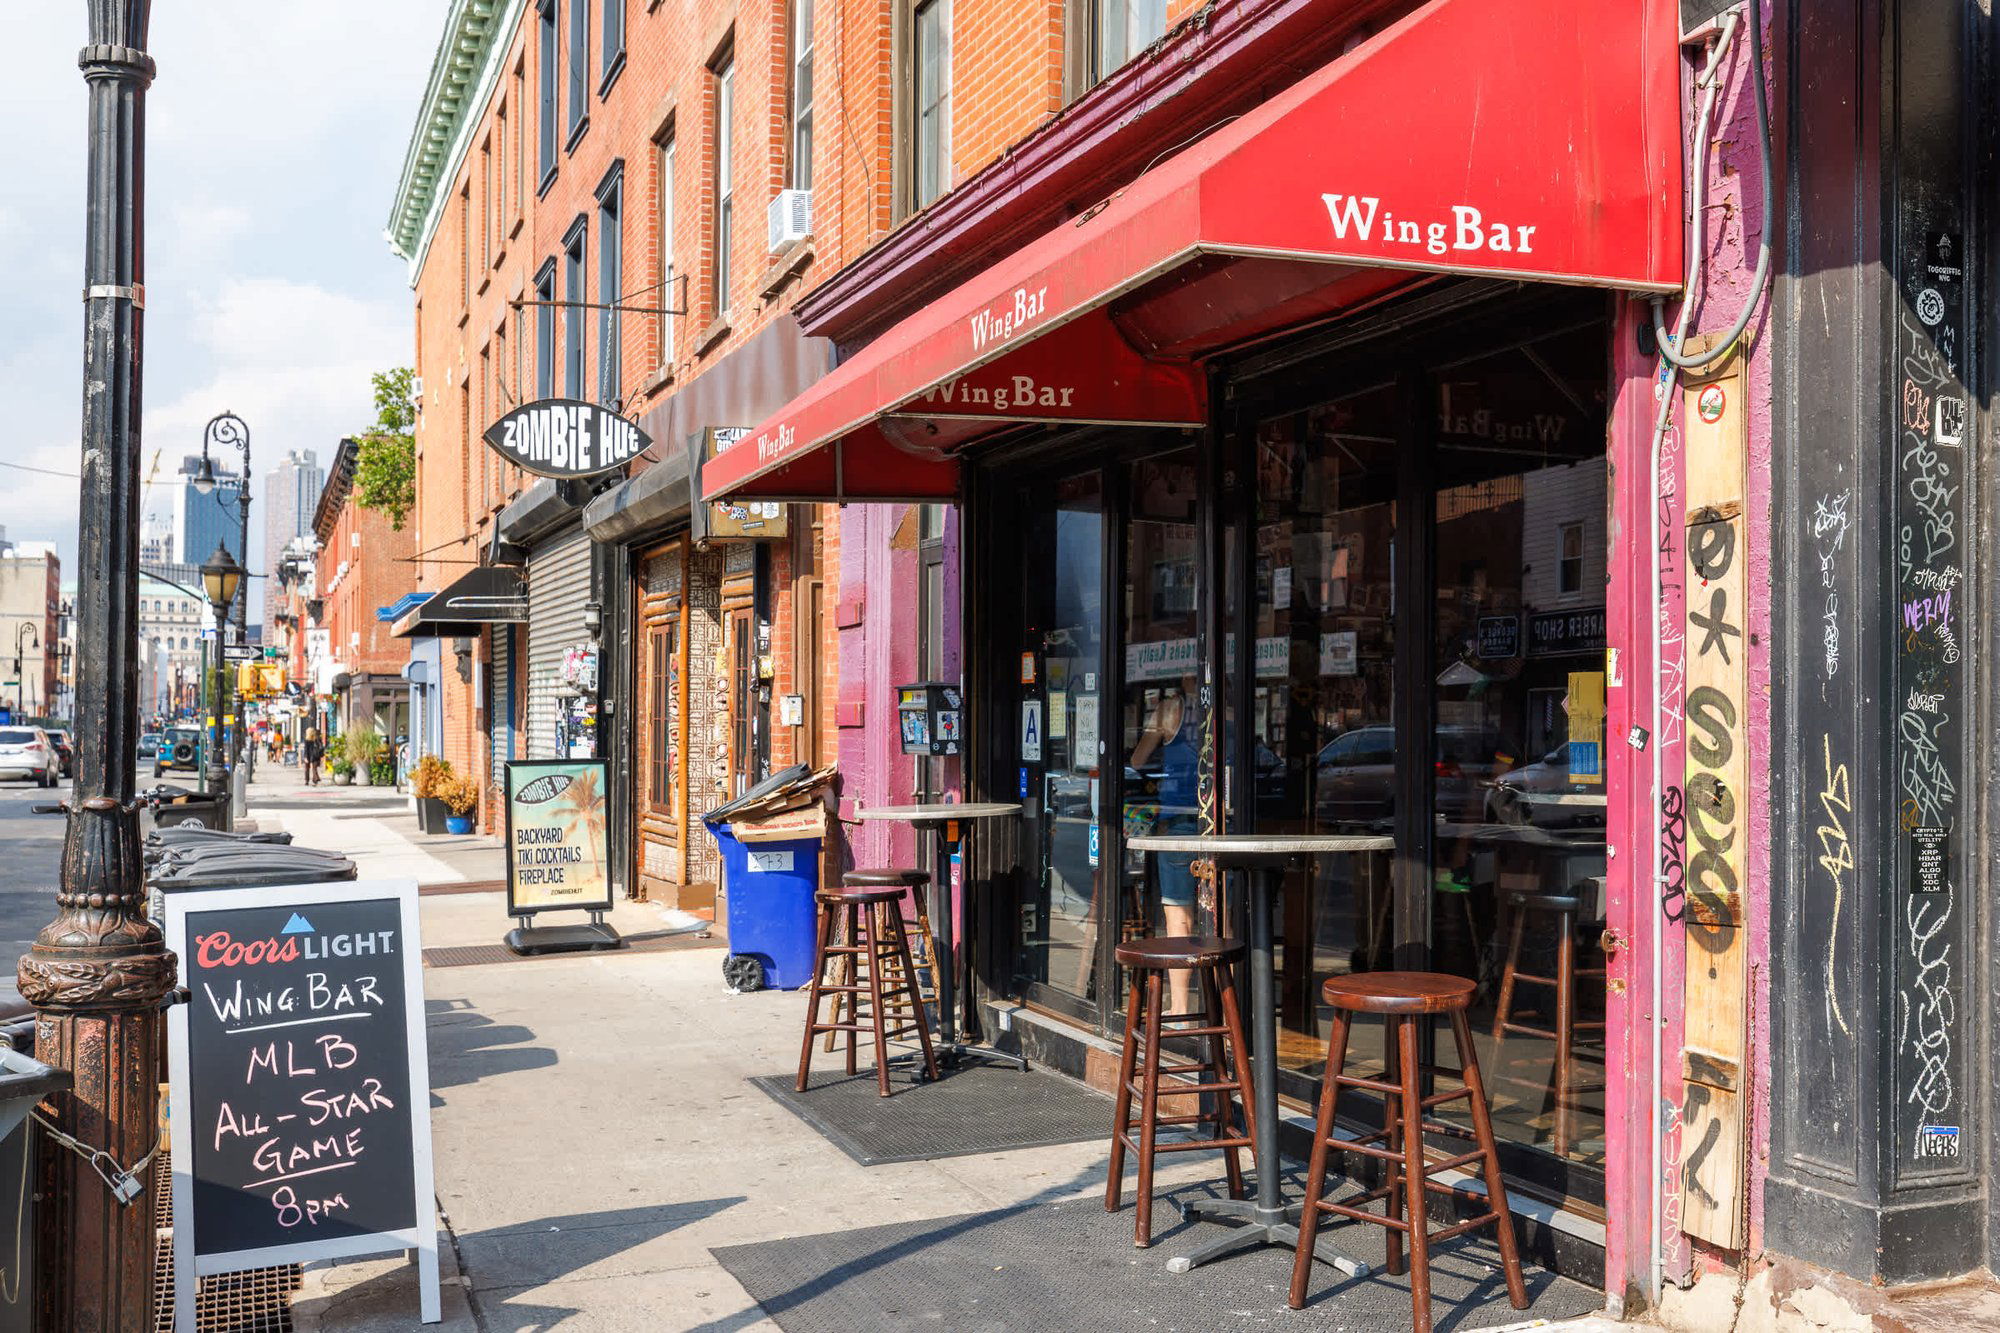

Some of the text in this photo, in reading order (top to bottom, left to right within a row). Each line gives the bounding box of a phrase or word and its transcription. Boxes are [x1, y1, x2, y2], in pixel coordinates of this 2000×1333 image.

[1321, 193, 1536, 255] WingBar
[971, 286, 1047, 351] WingBar
[757, 423, 795, 465] WingBar
[1025, 708, 1038, 743] A
[517, 827, 563, 845] BACKYARD
[196, 930, 394, 968] Coors LIGHT
[204, 972, 384, 1022] WING BAR
[246, 1034, 358, 1085] MLB
[252, 1127, 365, 1174] GAME
